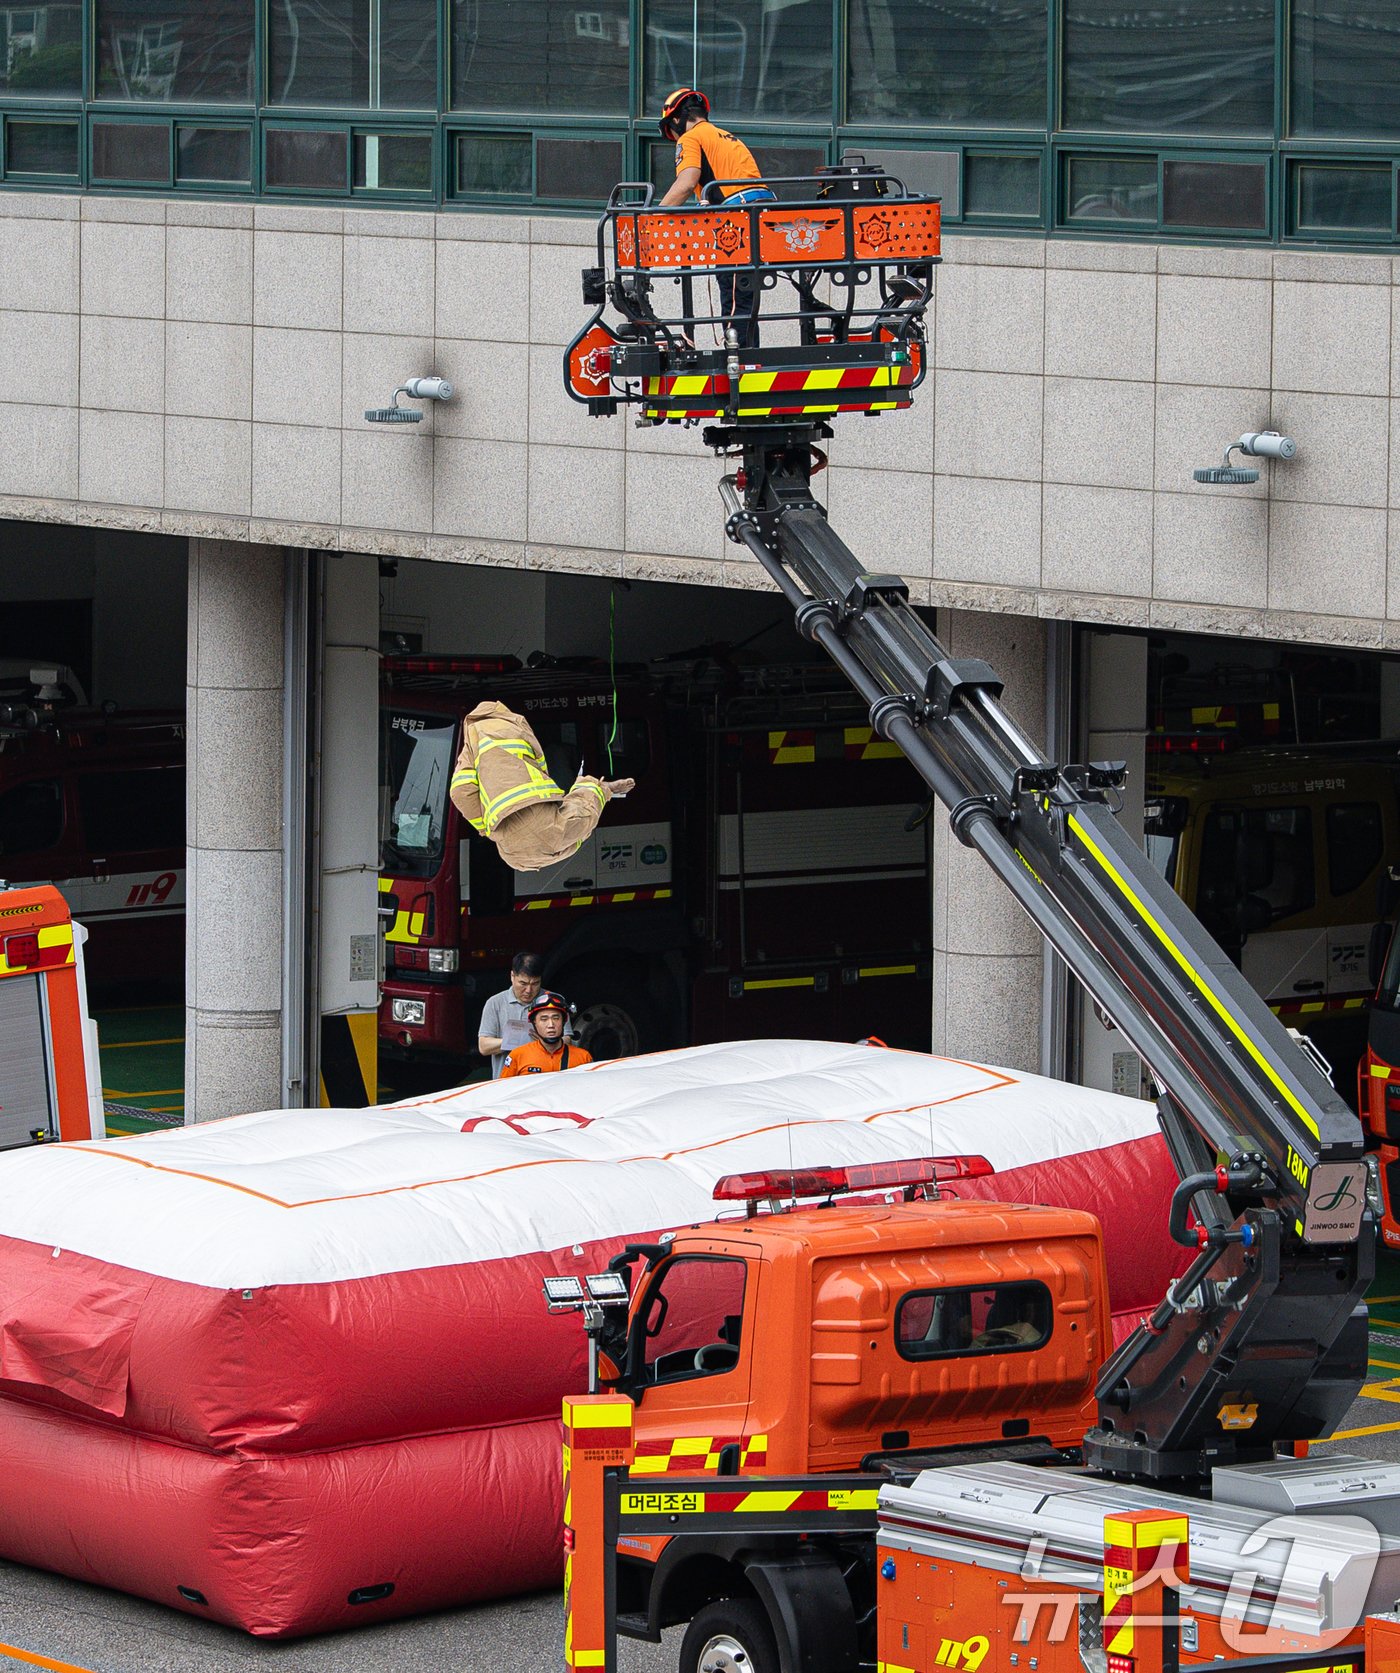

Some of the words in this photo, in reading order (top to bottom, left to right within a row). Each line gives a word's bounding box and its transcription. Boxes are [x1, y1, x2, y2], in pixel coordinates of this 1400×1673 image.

[524, 697, 569, 711] 경기도소방
[391, 716, 425, 733] 남부탱크
[125, 872, 177, 907] 119
[1286, 1144, 1309, 1189] 18M
[628, 1494, 697, 1511] 머리조심
[934, 1635, 990, 1673] 119
